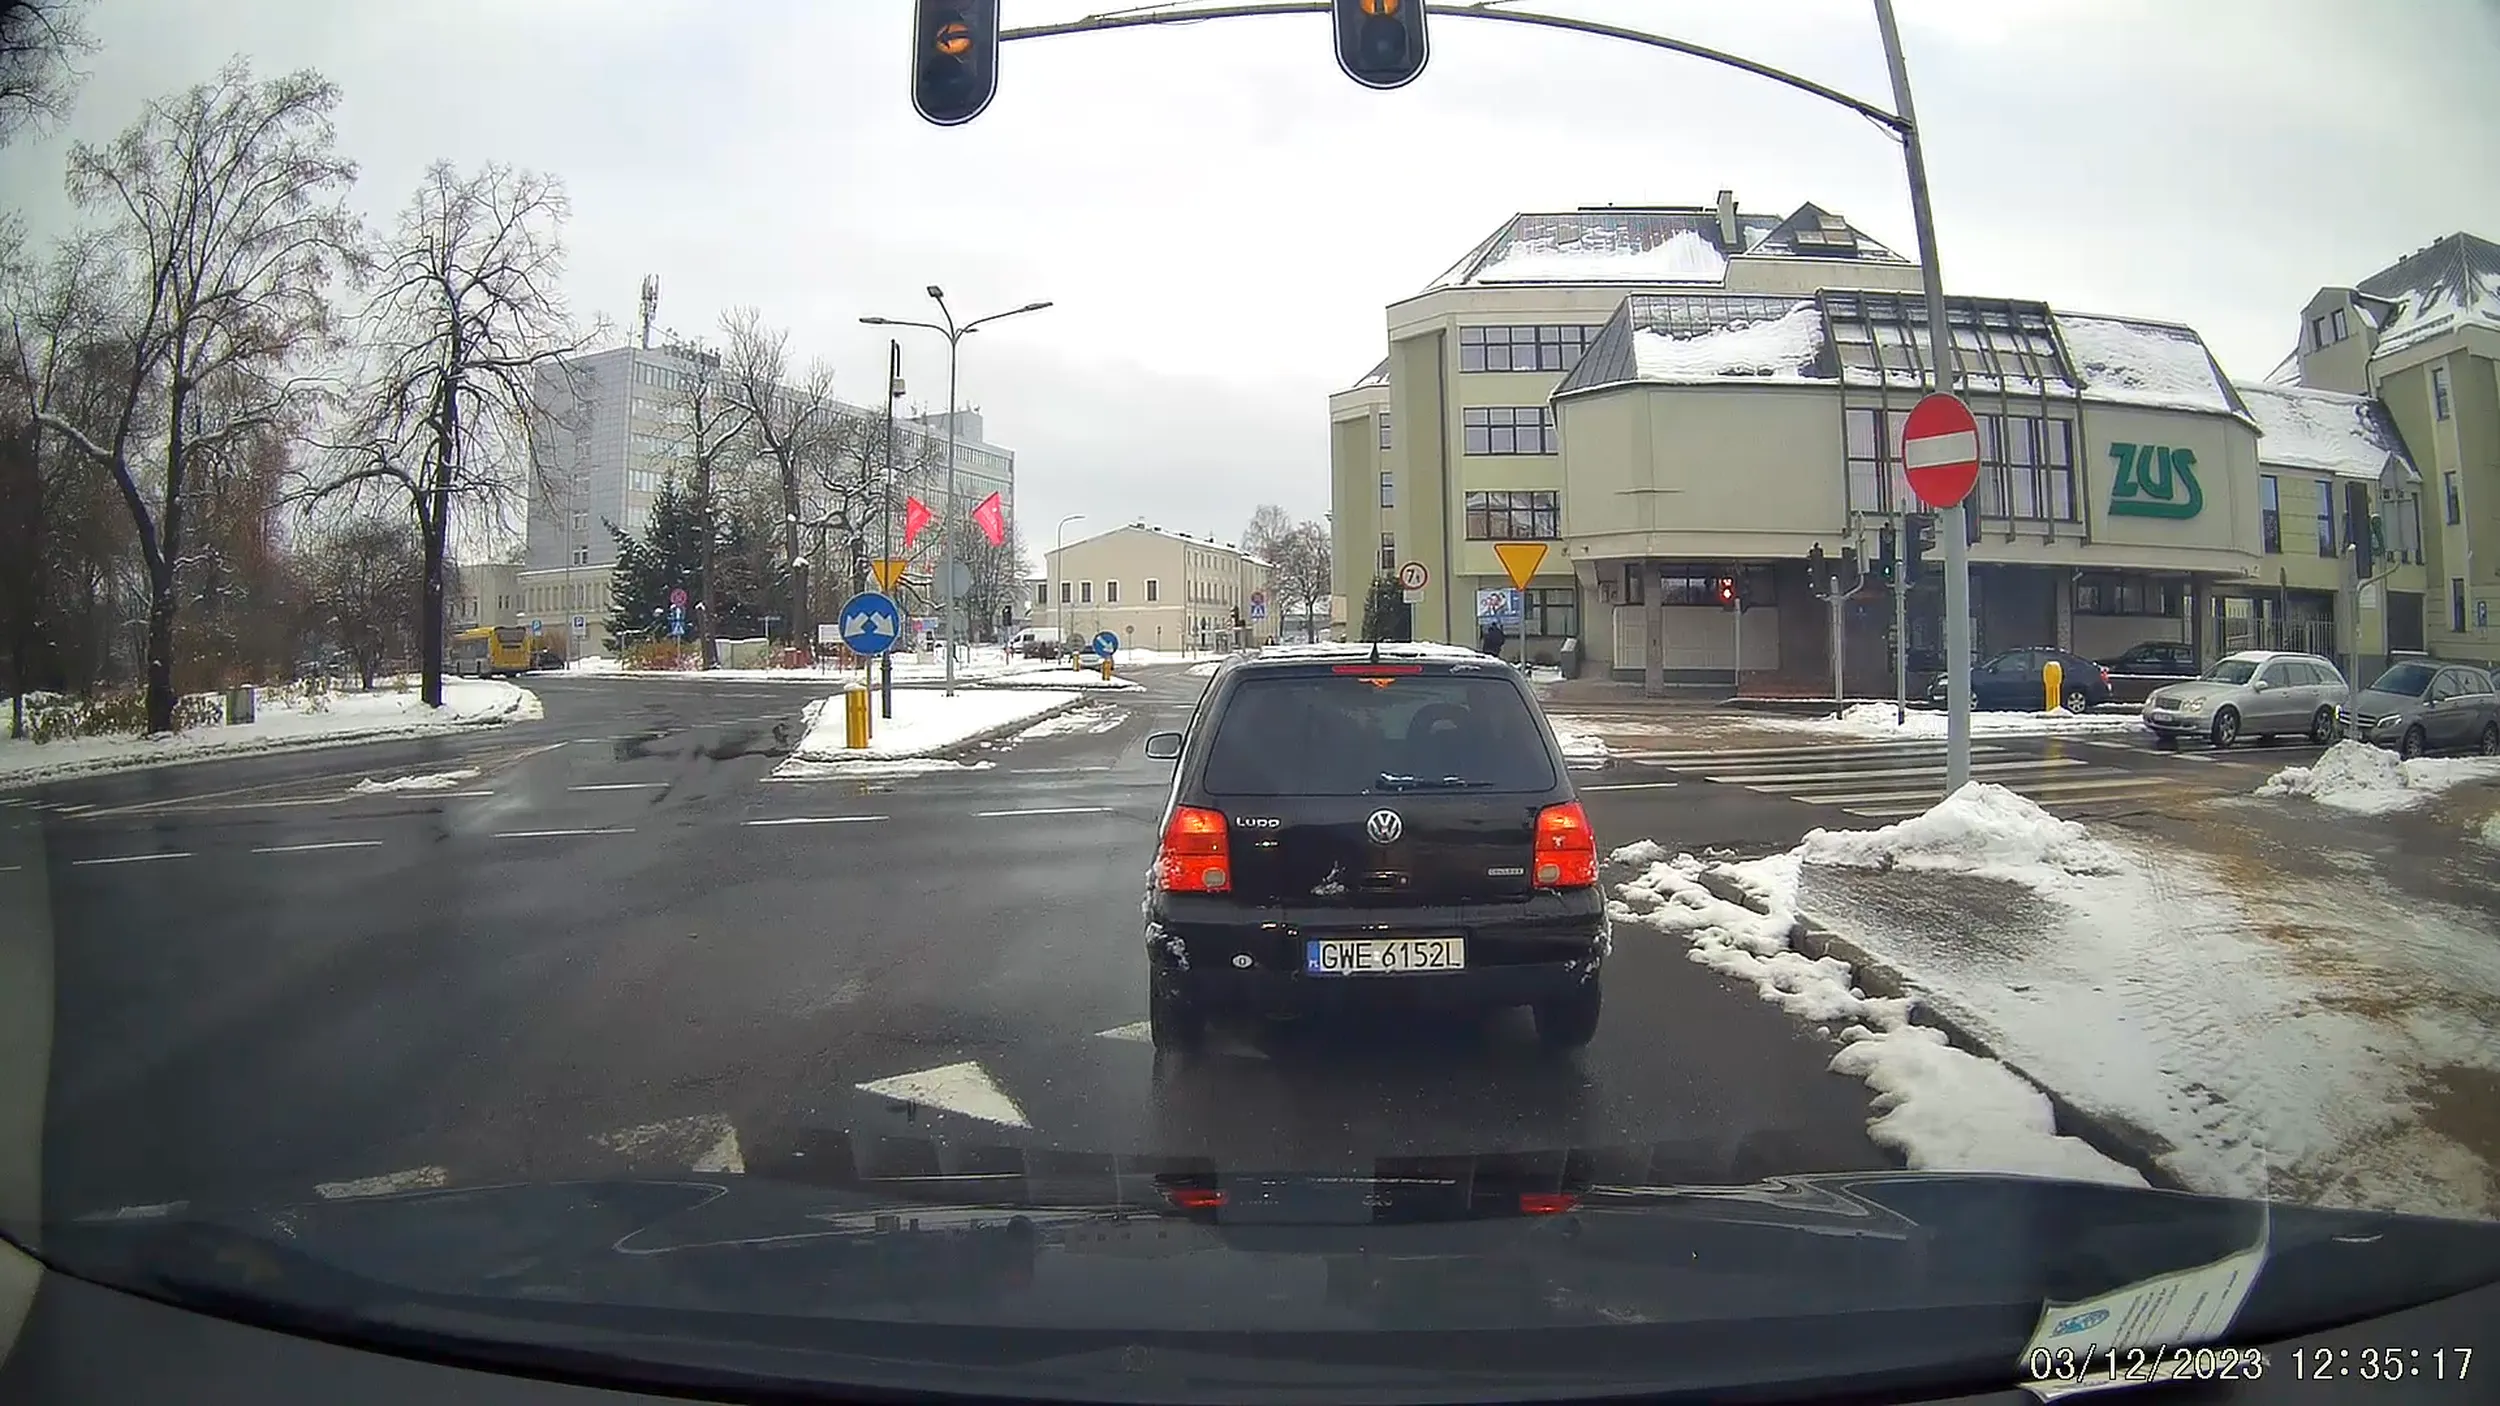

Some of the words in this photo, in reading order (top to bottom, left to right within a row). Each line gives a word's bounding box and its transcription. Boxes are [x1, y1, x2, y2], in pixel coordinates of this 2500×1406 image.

[2108, 442, 2203, 520] ZUS
[1322, 942, 1372, 969] GWE
[1382, 941, 1461, 968] 6152L
